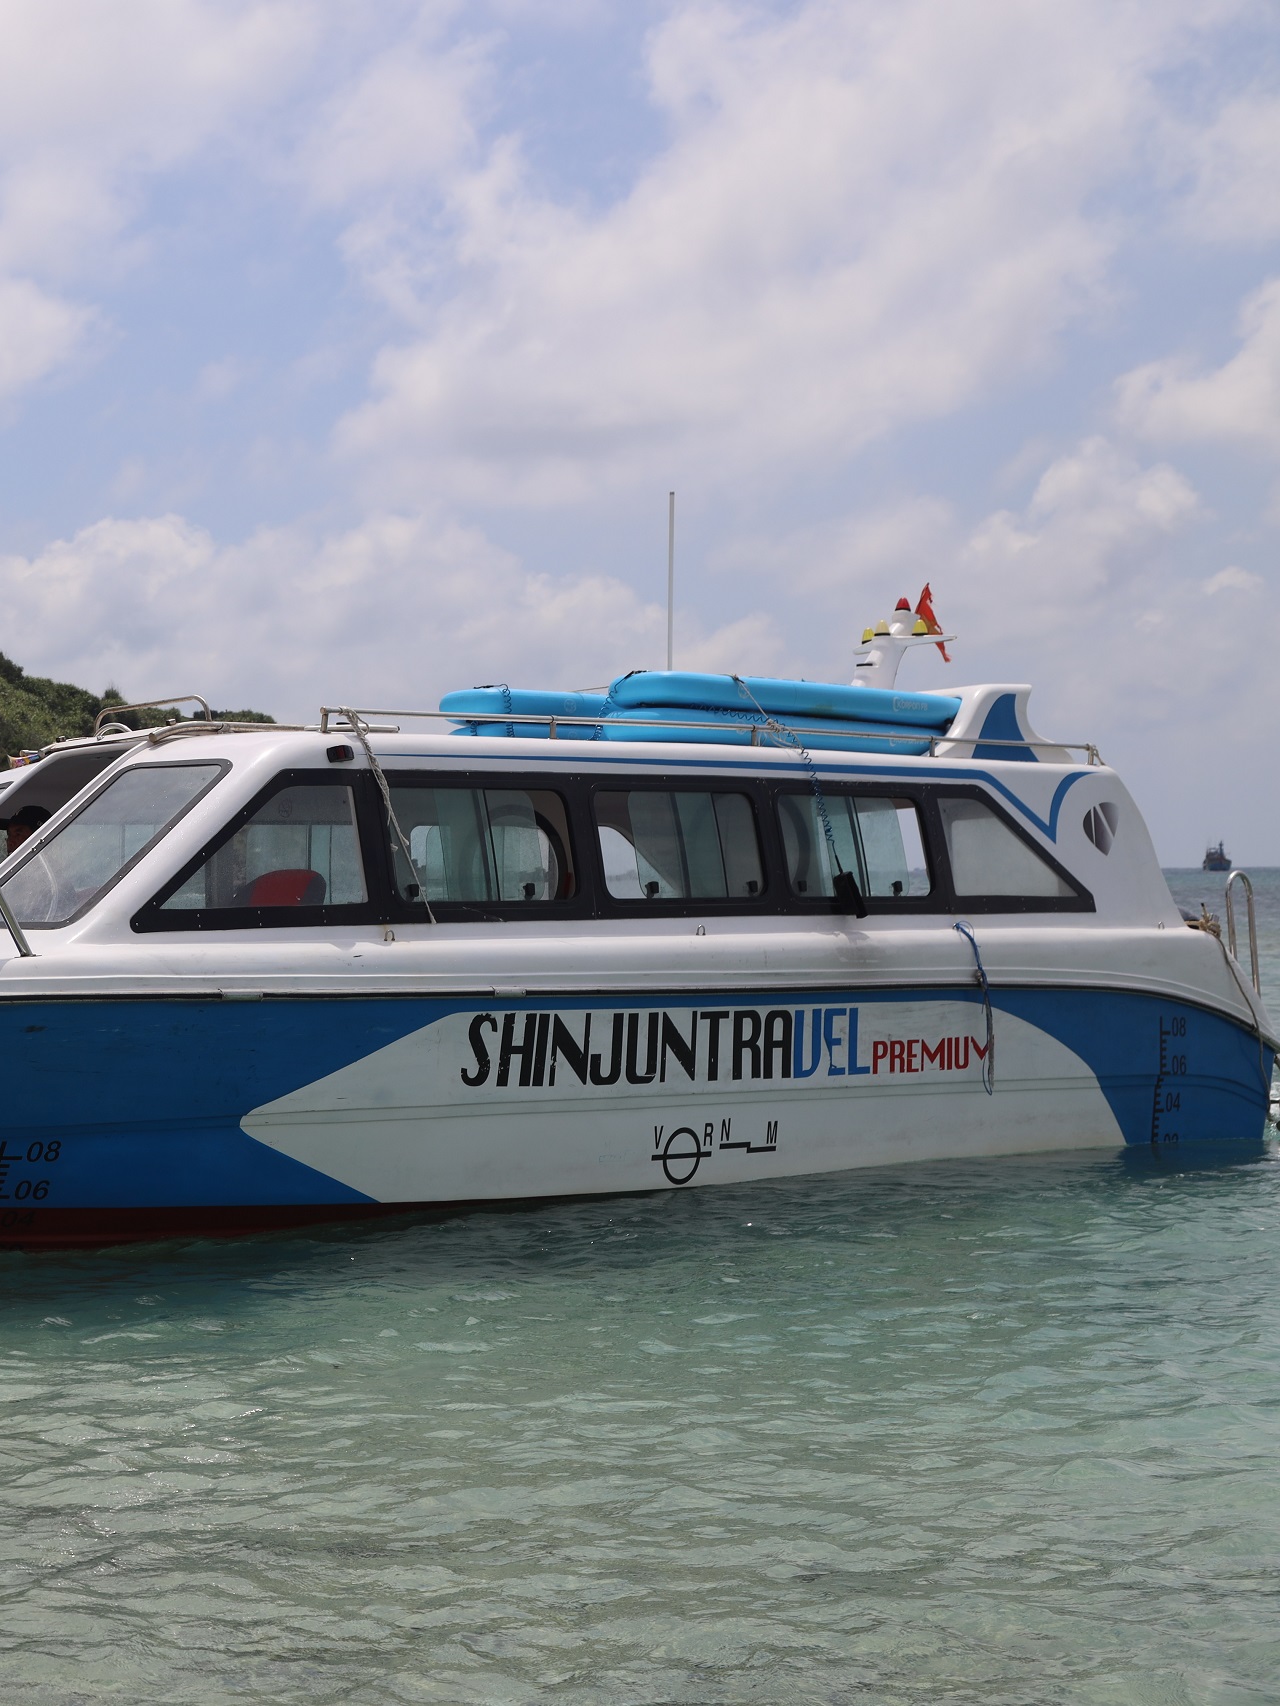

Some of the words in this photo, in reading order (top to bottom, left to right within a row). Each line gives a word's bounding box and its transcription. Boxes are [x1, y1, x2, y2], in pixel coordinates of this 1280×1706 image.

[1171, 1016, 1187, 1038] 08
[1171, 1055, 1187, 1076] 06
[1165, 1092, 1180, 1113] 04
[654, 1125, 664, 1150] V
[703, 1122, 714, 1147] R
[720, 1117, 732, 1142] N
[766, 1120, 779, 1145] M
[26, 1140, 62, 1163] 08
[14, 1179, 50, 1201] 06
[0, 1209, 36, 1228] 04
